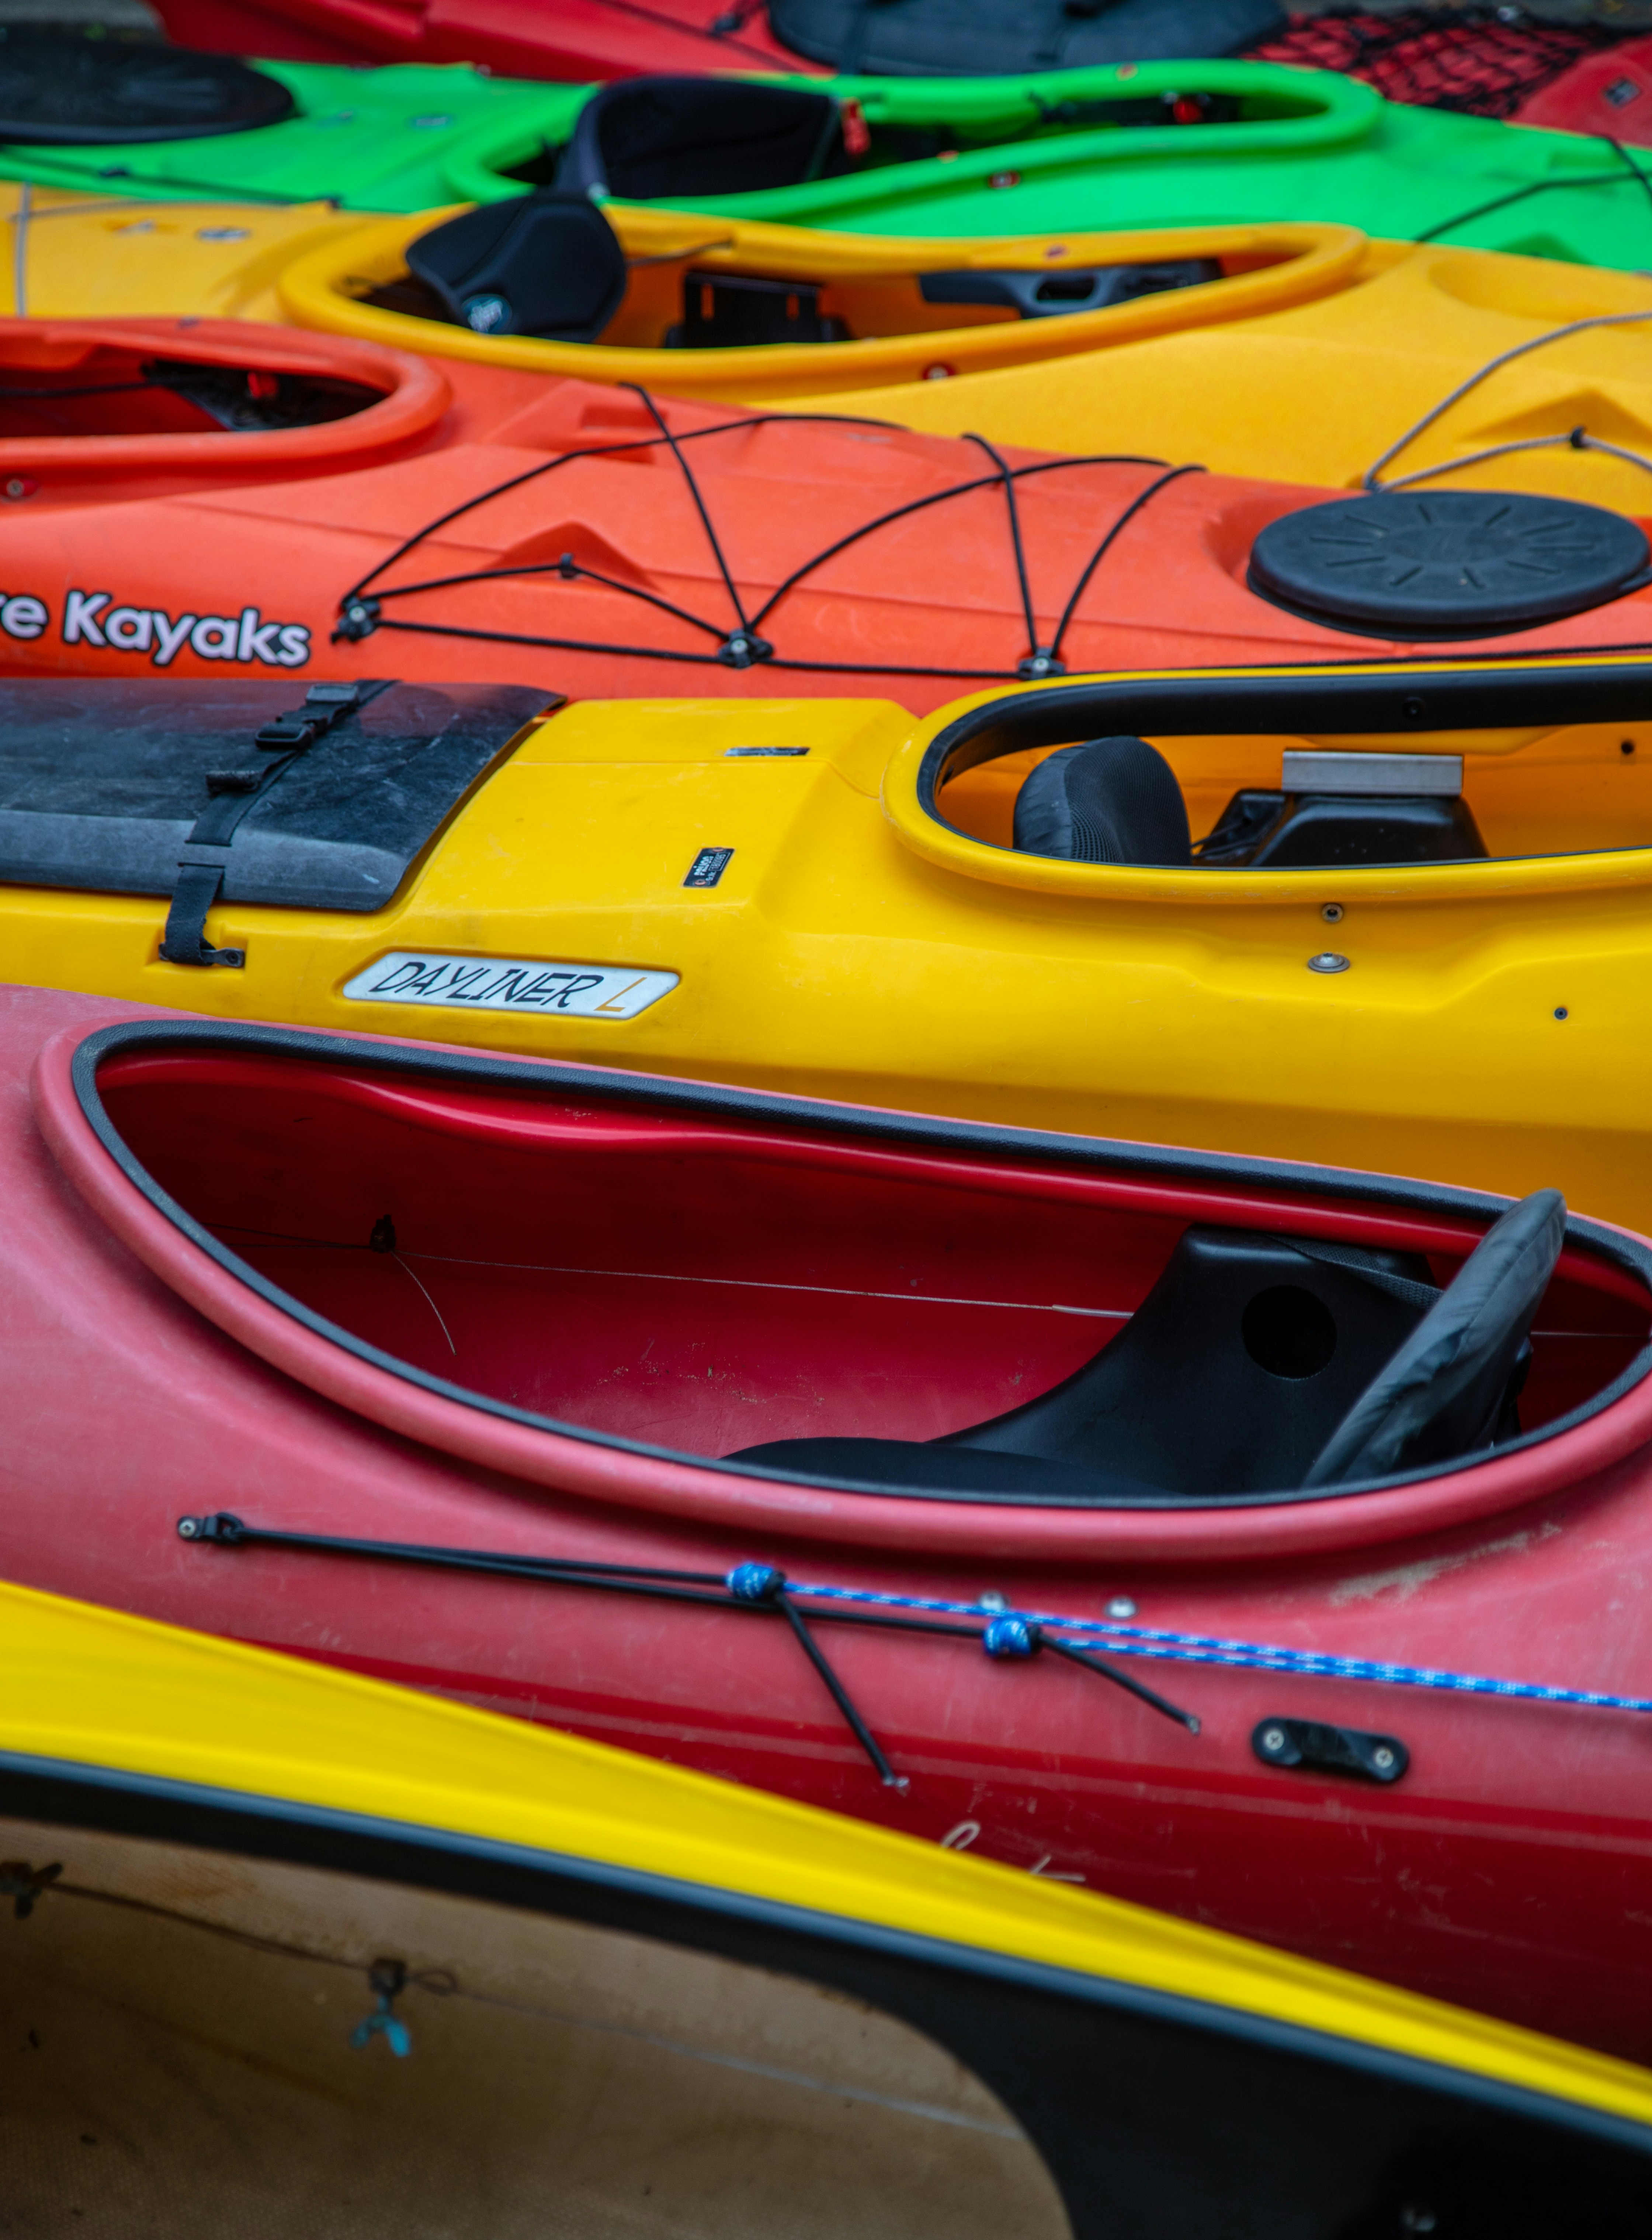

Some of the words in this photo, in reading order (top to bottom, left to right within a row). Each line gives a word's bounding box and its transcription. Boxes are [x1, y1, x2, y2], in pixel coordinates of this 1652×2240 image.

[0, 593, 49, 639] e
[63, 589, 311, 667] Kayaks
[369, 961, 604, 1008] DAYLINER
[593, 977, 647, 1012] L
